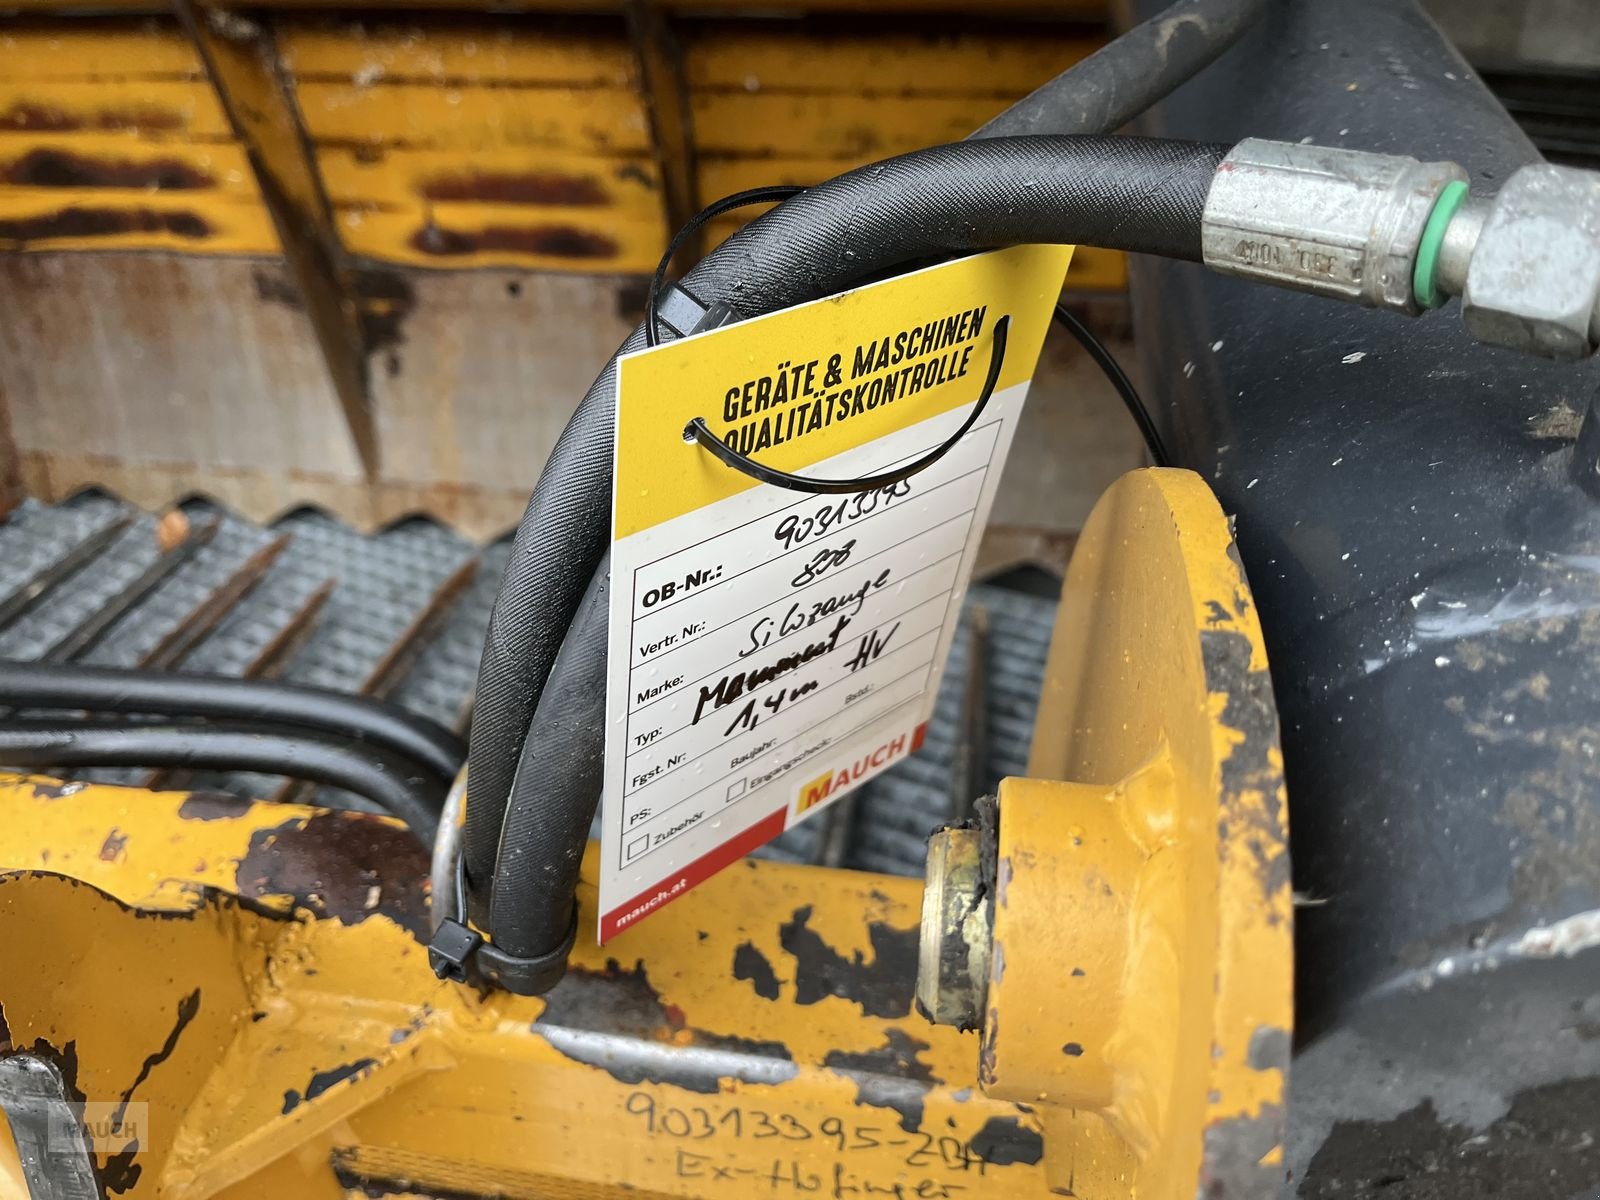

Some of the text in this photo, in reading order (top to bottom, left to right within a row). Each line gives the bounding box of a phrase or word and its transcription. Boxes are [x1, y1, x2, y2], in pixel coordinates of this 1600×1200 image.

[723, 305, 987, 422] GERÄTE & MASCHINEN
[724, 345, 974, 456] QUALITÄTSKONTROLLE
[642, 565, 722, 608] OB-Nr.:
[640, 621, 706, 657] Vertr. Nr.:
[637, 675, 684, 704] Marke:
[634, 726, 662, 746] Typ:
[730, 737, 777, 768] Baujahr:
[632, 765, 664, 787] Fgst.
[806, 733, 906, 808] MAUCH
[630, 807, 651, 825] PS:
[653, 810, 704, 845] Zubehör
[616, 878, 687, 927] mauch.at
